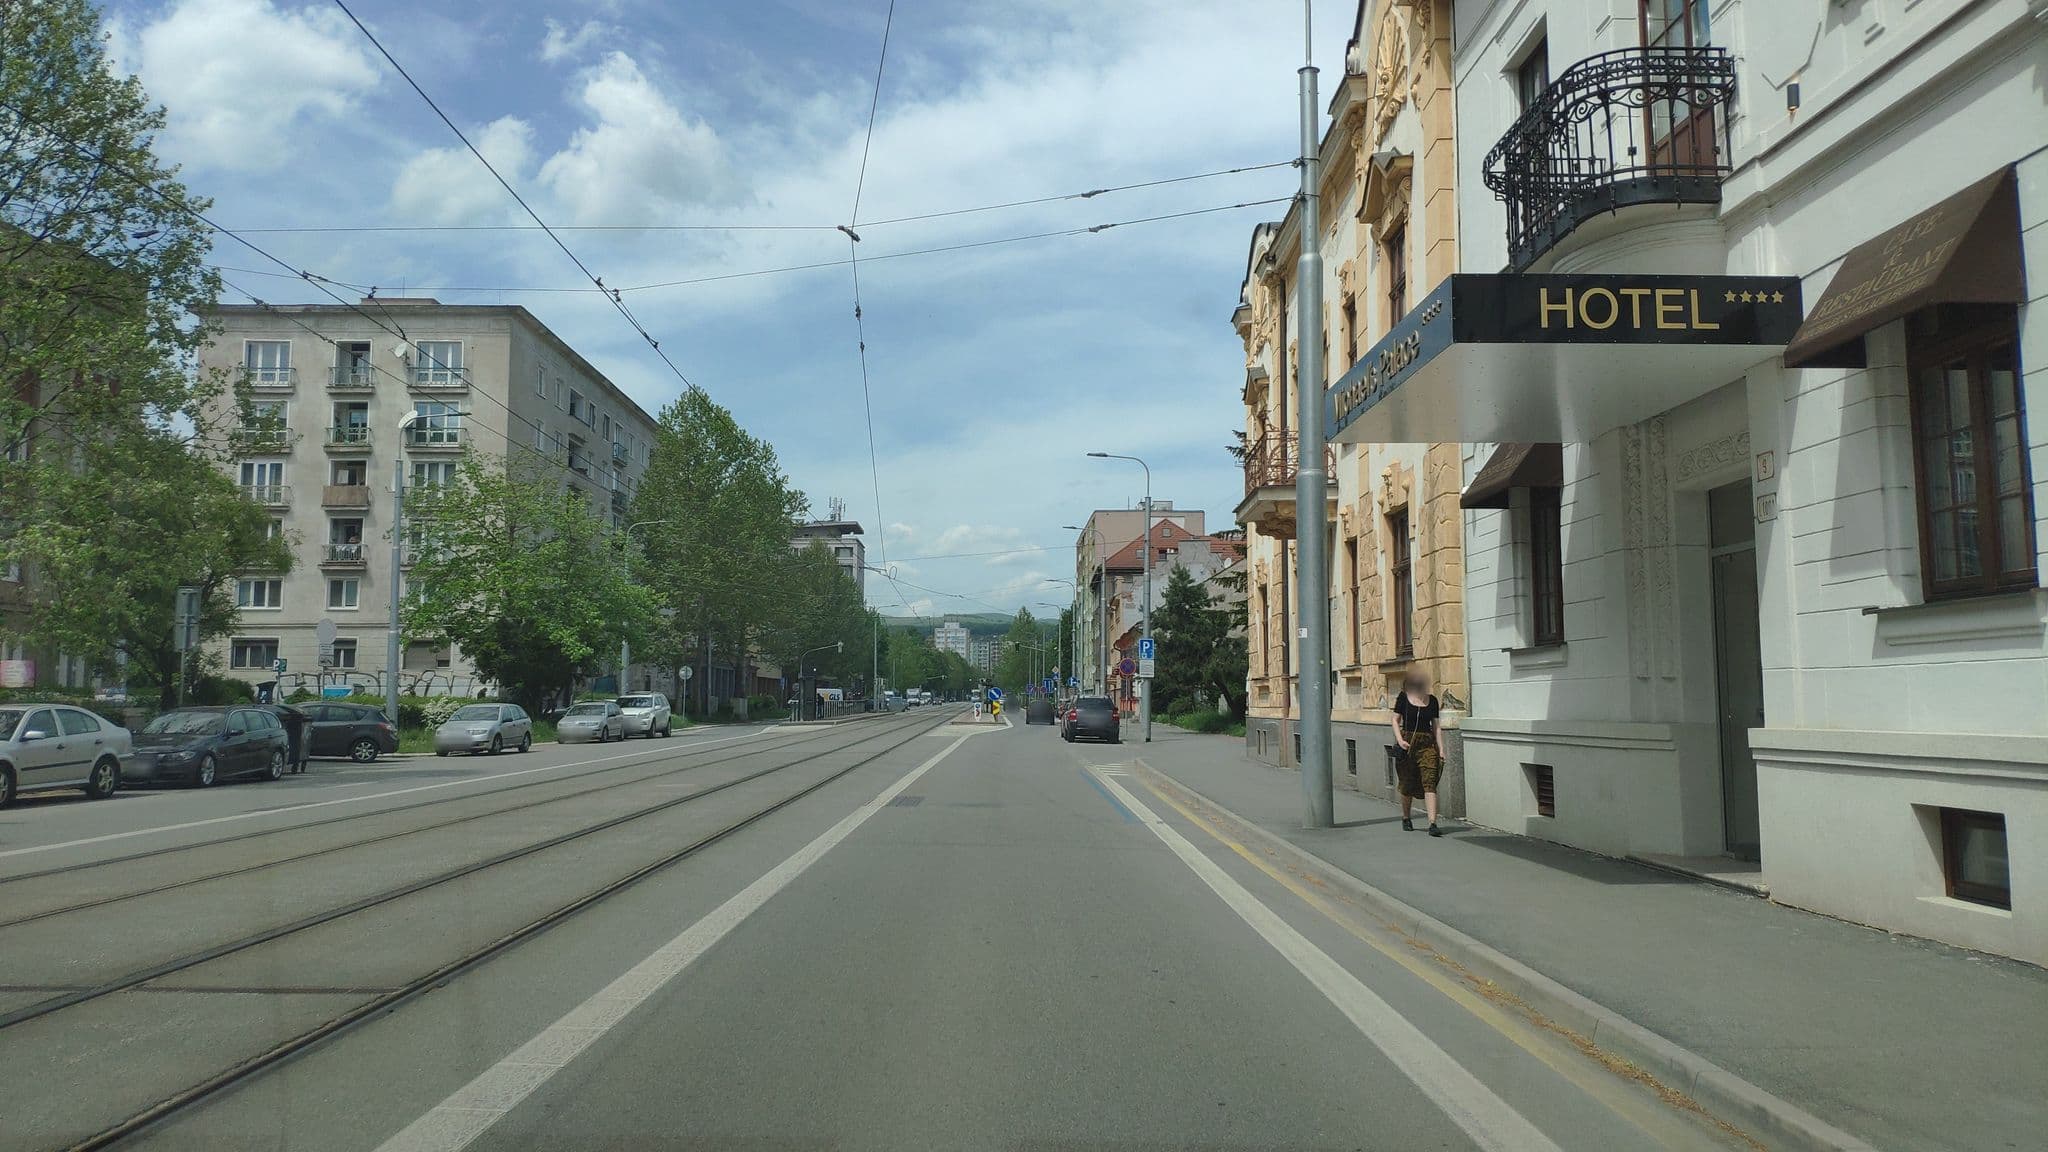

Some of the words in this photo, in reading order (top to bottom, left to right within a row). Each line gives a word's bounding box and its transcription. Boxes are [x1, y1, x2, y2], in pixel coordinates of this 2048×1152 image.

[1540, 287, 1720, 330] HOTEL
[1379, 330, 1420, 386] Palace
[1143, 641, 1150, 653] P
